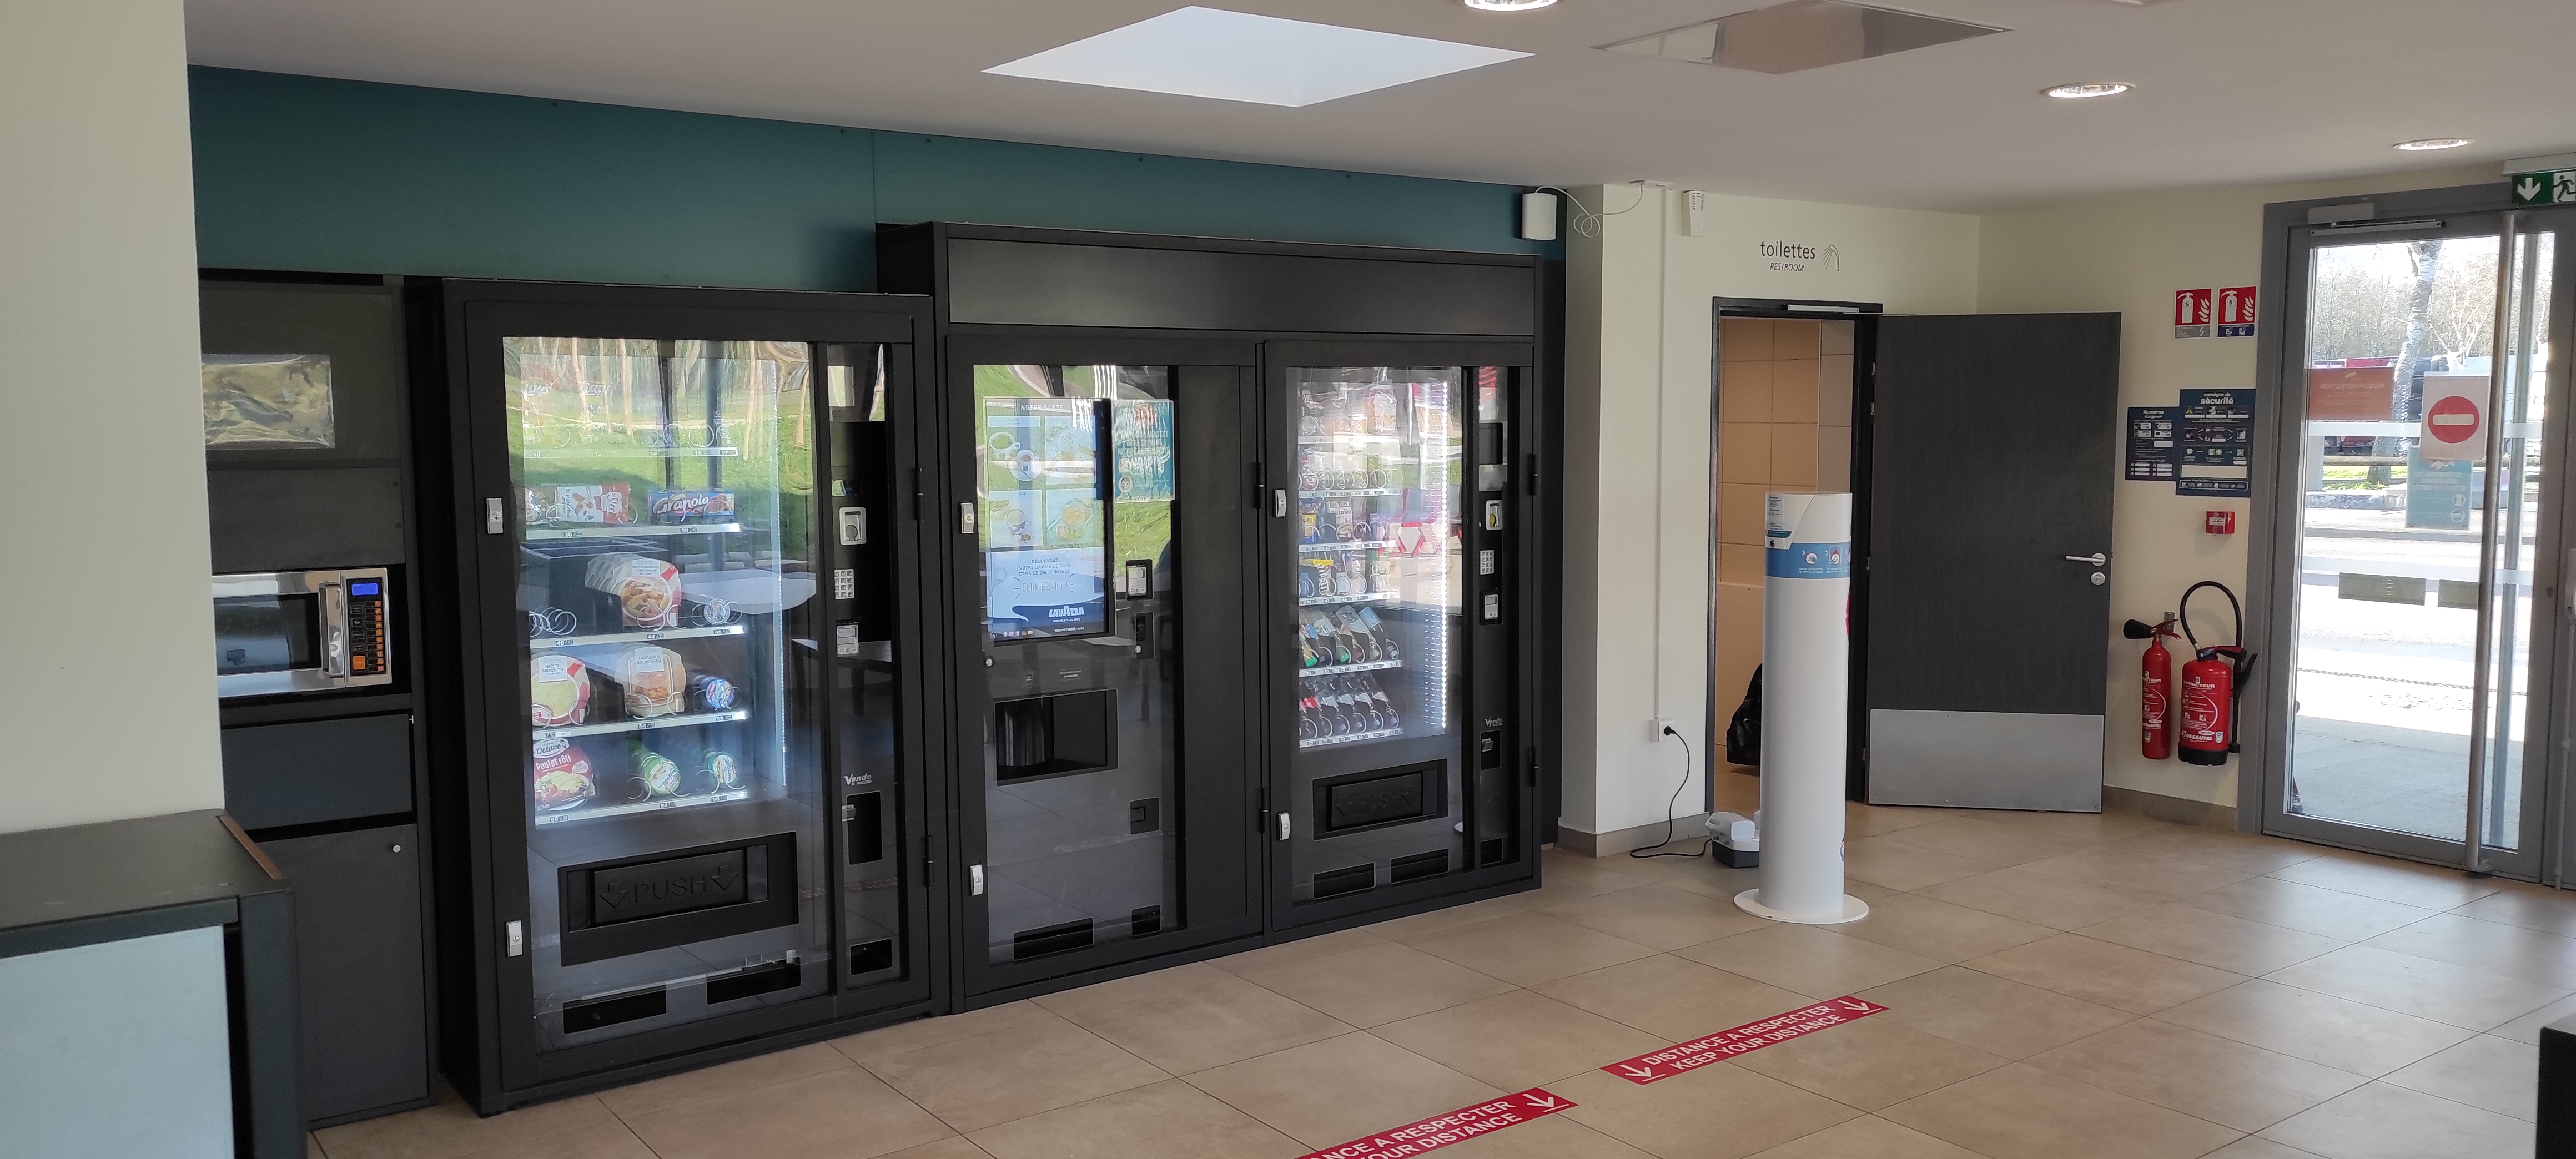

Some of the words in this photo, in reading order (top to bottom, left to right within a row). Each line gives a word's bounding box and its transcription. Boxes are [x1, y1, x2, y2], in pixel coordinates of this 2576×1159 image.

[1760, 240, 1815, 259] toilettes
[1769, 263, 1804, 272] RESTROOM
[2200, 396, 2234, 405] sécurité
[652, 494, 710, 514] Granola
[1022, 581, 1063, 593] CLIQUEZ-ICI
[1048, 605, 1085, 618] LAVAZZA
[535, 757, 559, 771] Poulet
[843, 773, 872, 785] Vendo
[634, 873, 707, 903] PUSH
[1641, 1036, 1725, 1065] DISTANCE
[1726, 1031, 1743, 1042] A
[1739, 1005, 1837, 1036] RESPECTER
[1669, 1051, 1723, 1070] KEEP
[1717, 1037, 1773, 1055] YOUR
[1764, 1014, 1848, 1041] DISTANCE
[1373, 1138, 1395, 1148] A
[1389, 1100, 1517, 1142] RESPECTER
[1416, 1112, 1523, 1148] DISTANCE
